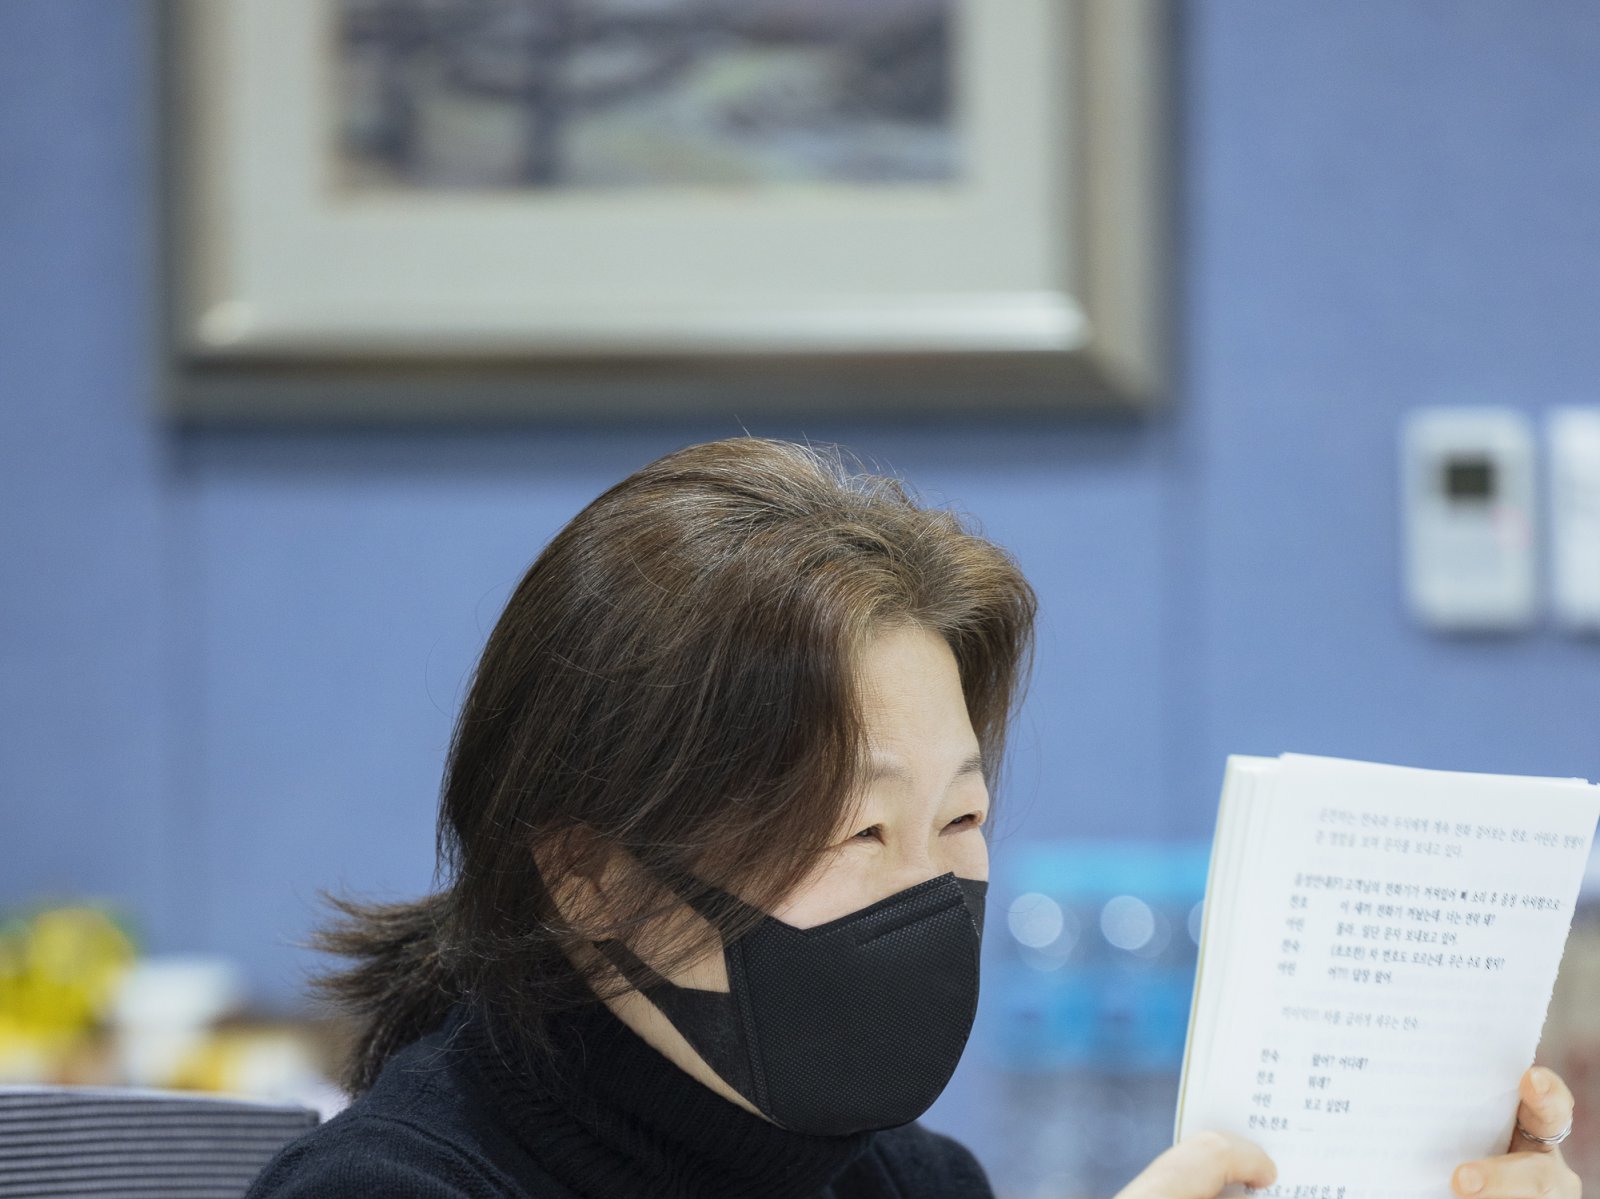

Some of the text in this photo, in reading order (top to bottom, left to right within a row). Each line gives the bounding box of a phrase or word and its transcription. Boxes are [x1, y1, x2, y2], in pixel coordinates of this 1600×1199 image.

[1376, 903, 1403, 920] 전화기
[1384, 927, 1402, 942] 문자
[1304, 1098, 1321, 1111] 보고
